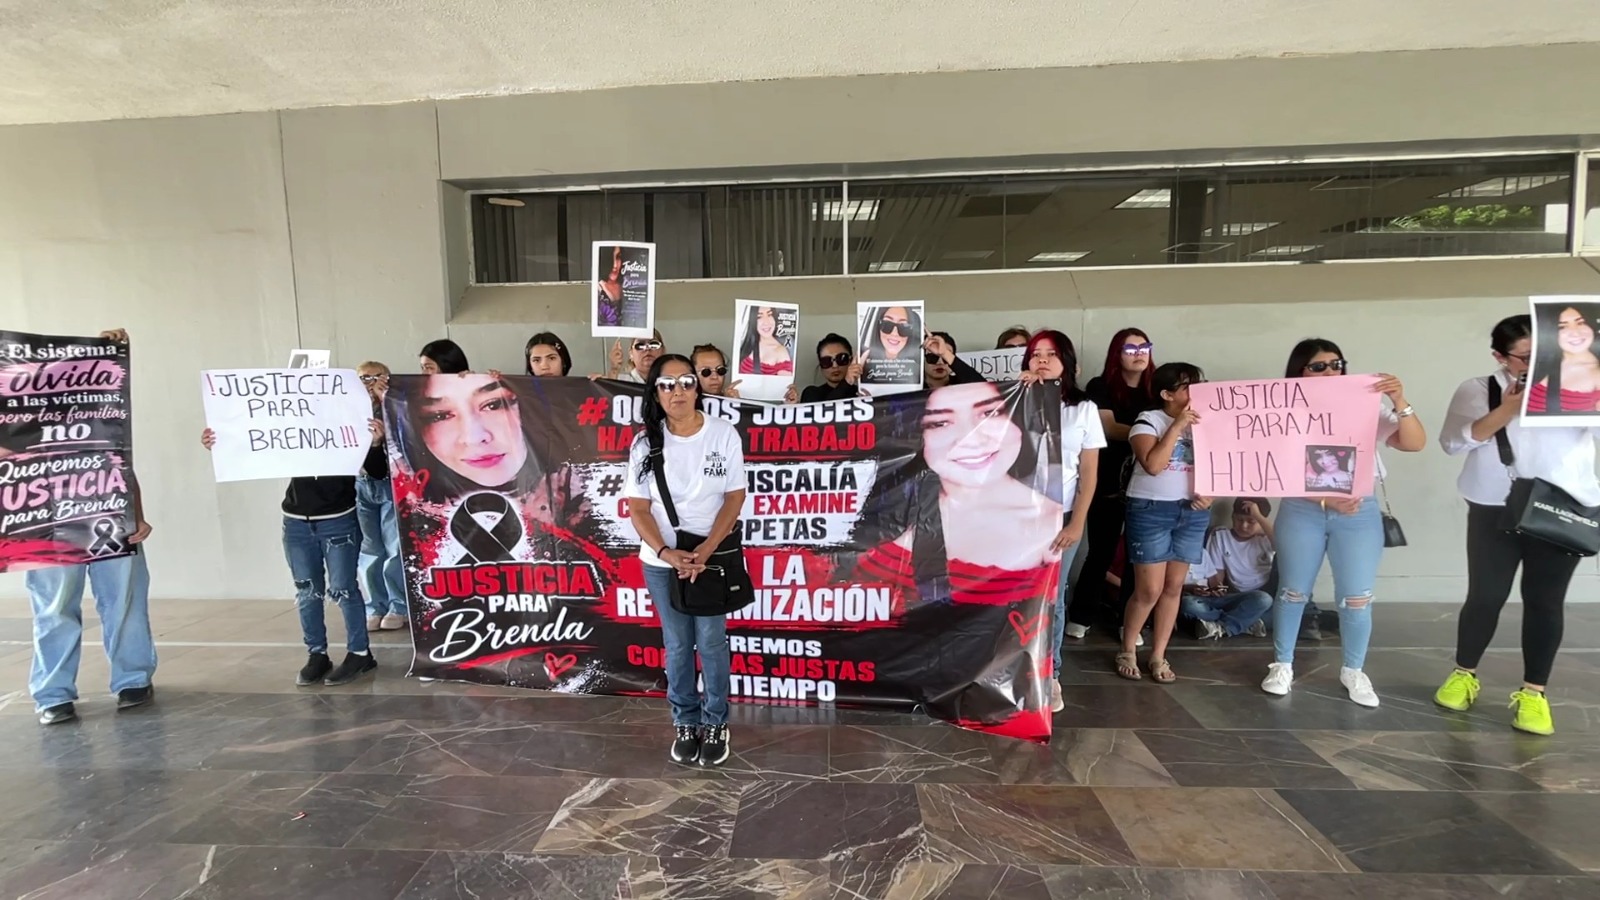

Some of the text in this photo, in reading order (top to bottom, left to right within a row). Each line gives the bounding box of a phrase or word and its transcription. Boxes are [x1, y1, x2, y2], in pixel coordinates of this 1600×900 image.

[8, 343, 117, 359] El sistema
[9, 360, 118, 394] olvida
[7, 391, 125, 407] a las víctimas,
[247, 398, 315, 418] PARA
[576, 395, 874, 426] #QU OS JUECES
[1208, 382, 1309, 412] JUSTICIA
[38, 405, 64, 421] las
[66, 404, 128, 424] familias
[40, 423, 91, 442] no
[248, 425, 359, 452] BRENDA!!!
[747, 423, 875, 451] TRABAJO
[0, 455, 105, 484] Queremos
[703, 467, 727, 477] FAMA
[744, 466, 857, 493] ISCALÍA
[1209, 451, 1285, 493] HIJA
[0, 468, 128, 511] USTICIA
[1, 493, 128, 533] para Brenda
[753, 492, 858, 516] EXAMINE
[1533, 501, 1555, 514] KARL
[424, 563, 596, 598] JUSTICIA
[762, 555, 806, 585] LA
[488, 595, 549, 613] PARA
[430, 607, 594, 663] Brenda
[725, 634, 822, 657] REMOS
[771, 657, 875, 682] JUSTAS
[729, 675, 836, 702] TIEMPO
